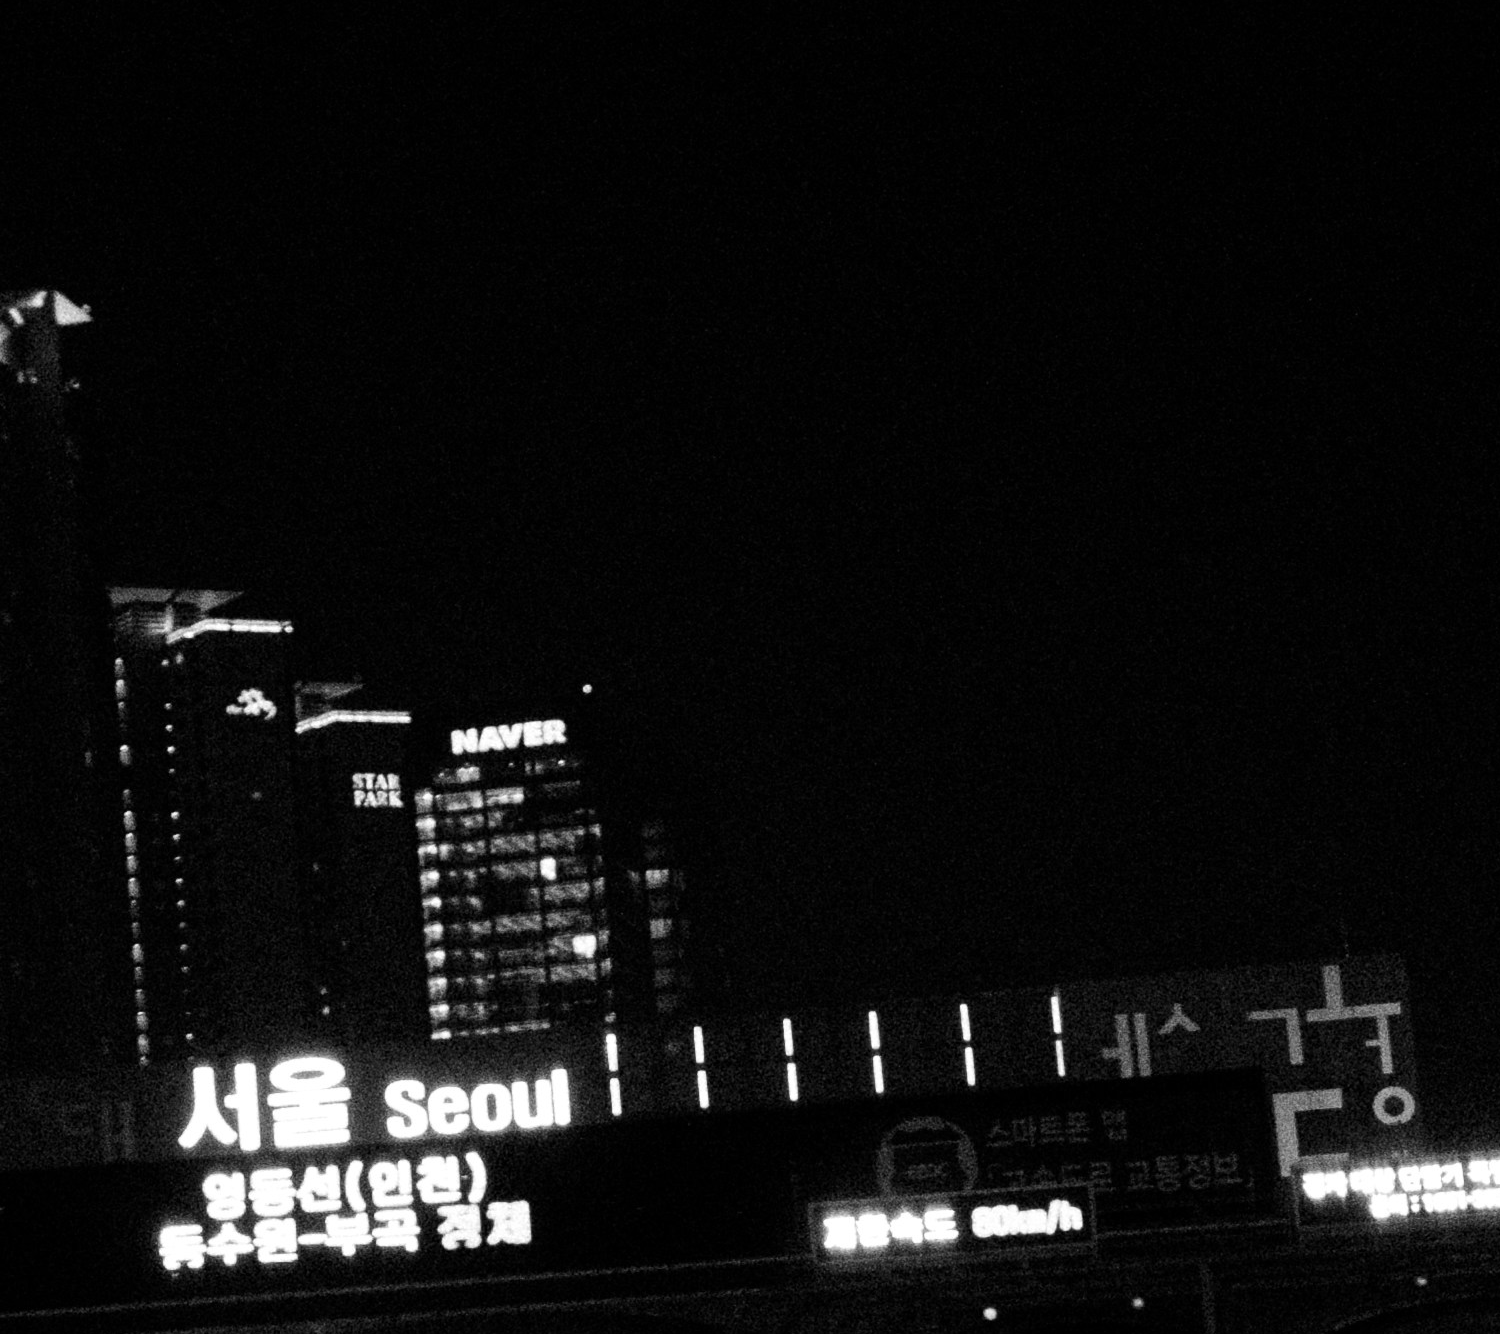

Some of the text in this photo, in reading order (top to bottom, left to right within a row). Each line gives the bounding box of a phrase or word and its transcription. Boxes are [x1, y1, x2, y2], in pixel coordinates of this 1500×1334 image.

[450, 718, 567, 756] NAVER
[352, 772, 400, 789] STAR
[353, 790, 404, 808] PARK
[178, 1056, 352, 1152] 서울
[384, 1068, 572, 1139] Seoul
[985, 1111, 1092, 1148] 스마트폰
[202, 1151, 487, 1221] 영동선(인천)
[971, 1199, 1083, 1237] 80km/h
